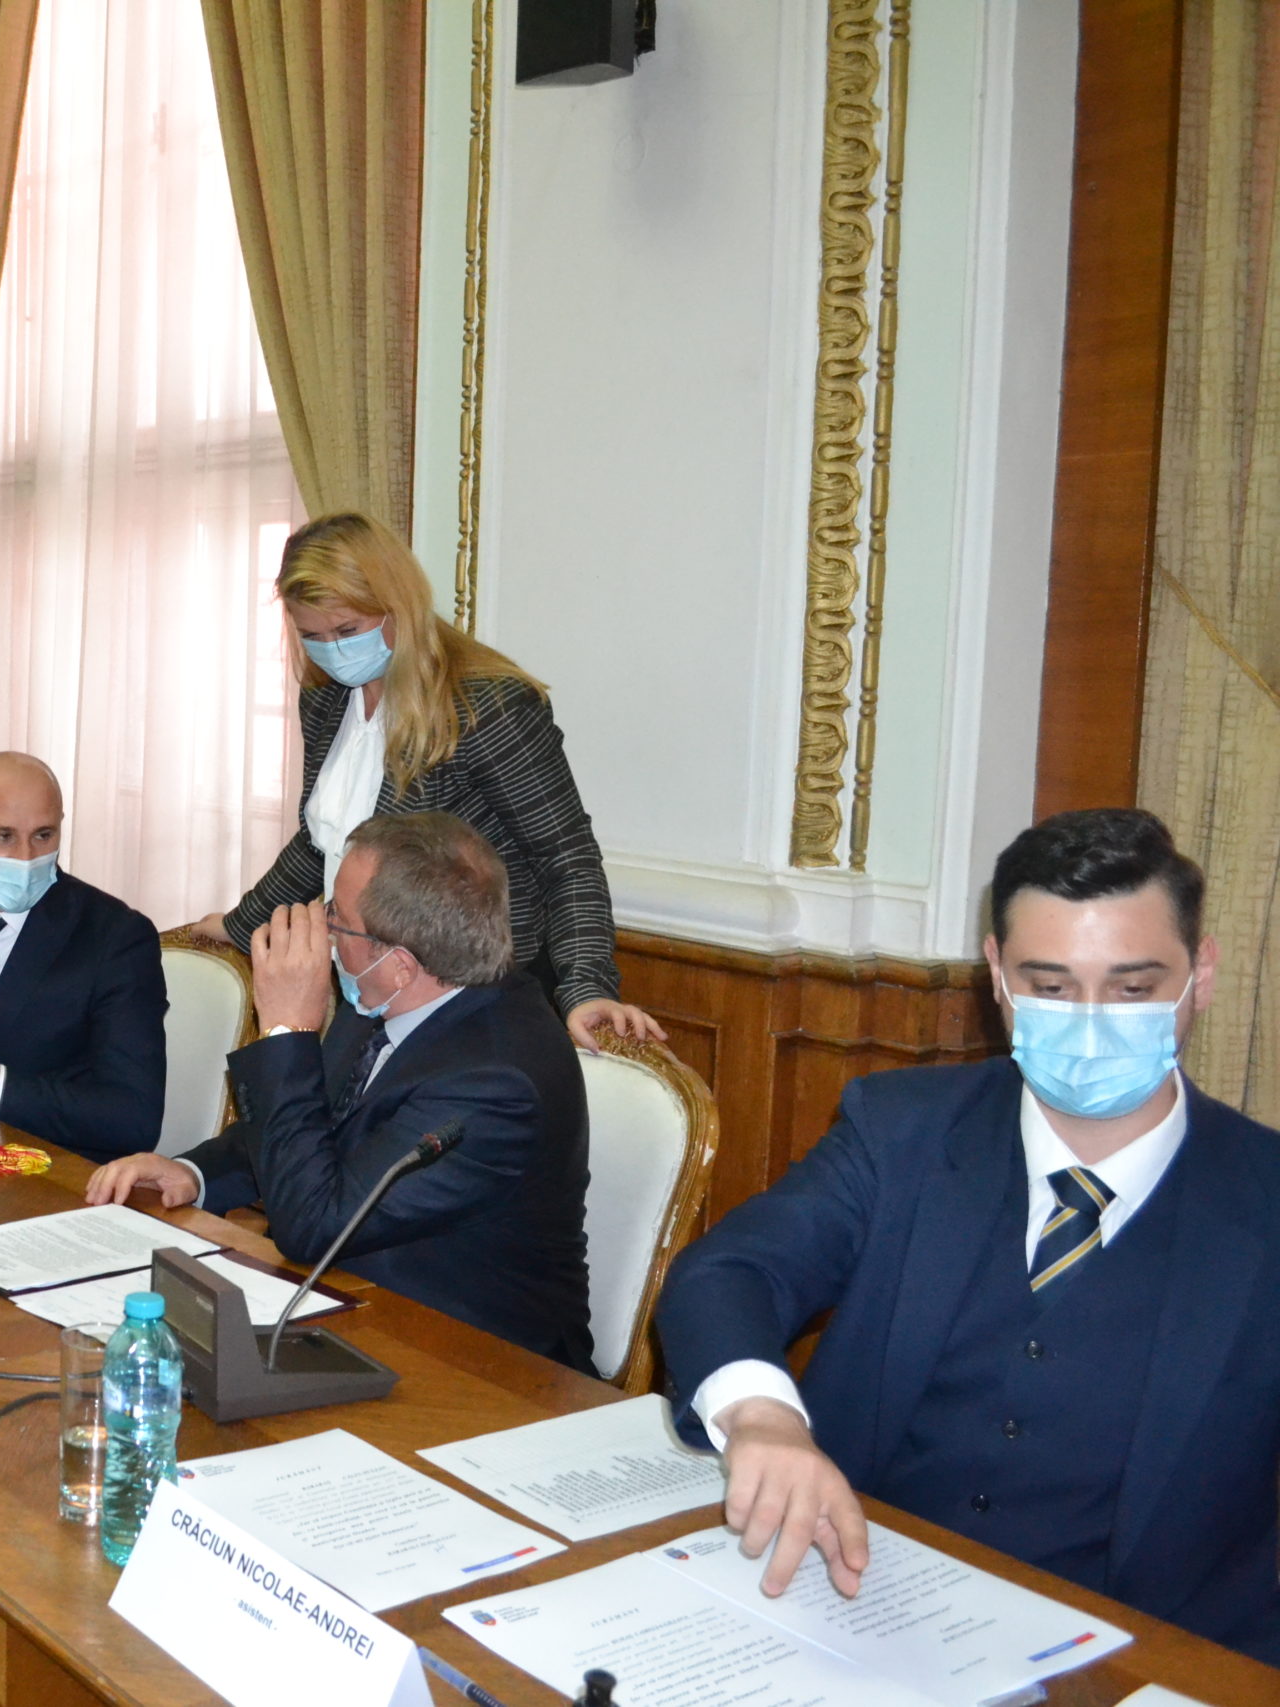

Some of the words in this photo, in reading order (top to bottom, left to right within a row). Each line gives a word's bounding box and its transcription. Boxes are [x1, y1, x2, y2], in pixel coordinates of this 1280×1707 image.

[171, 1508, 236, 1564] CRĂCIUN
[237, 1553, 375, 1659] NICOLAE-ANDREI
[238, 1599, 274, 1629] asistent
